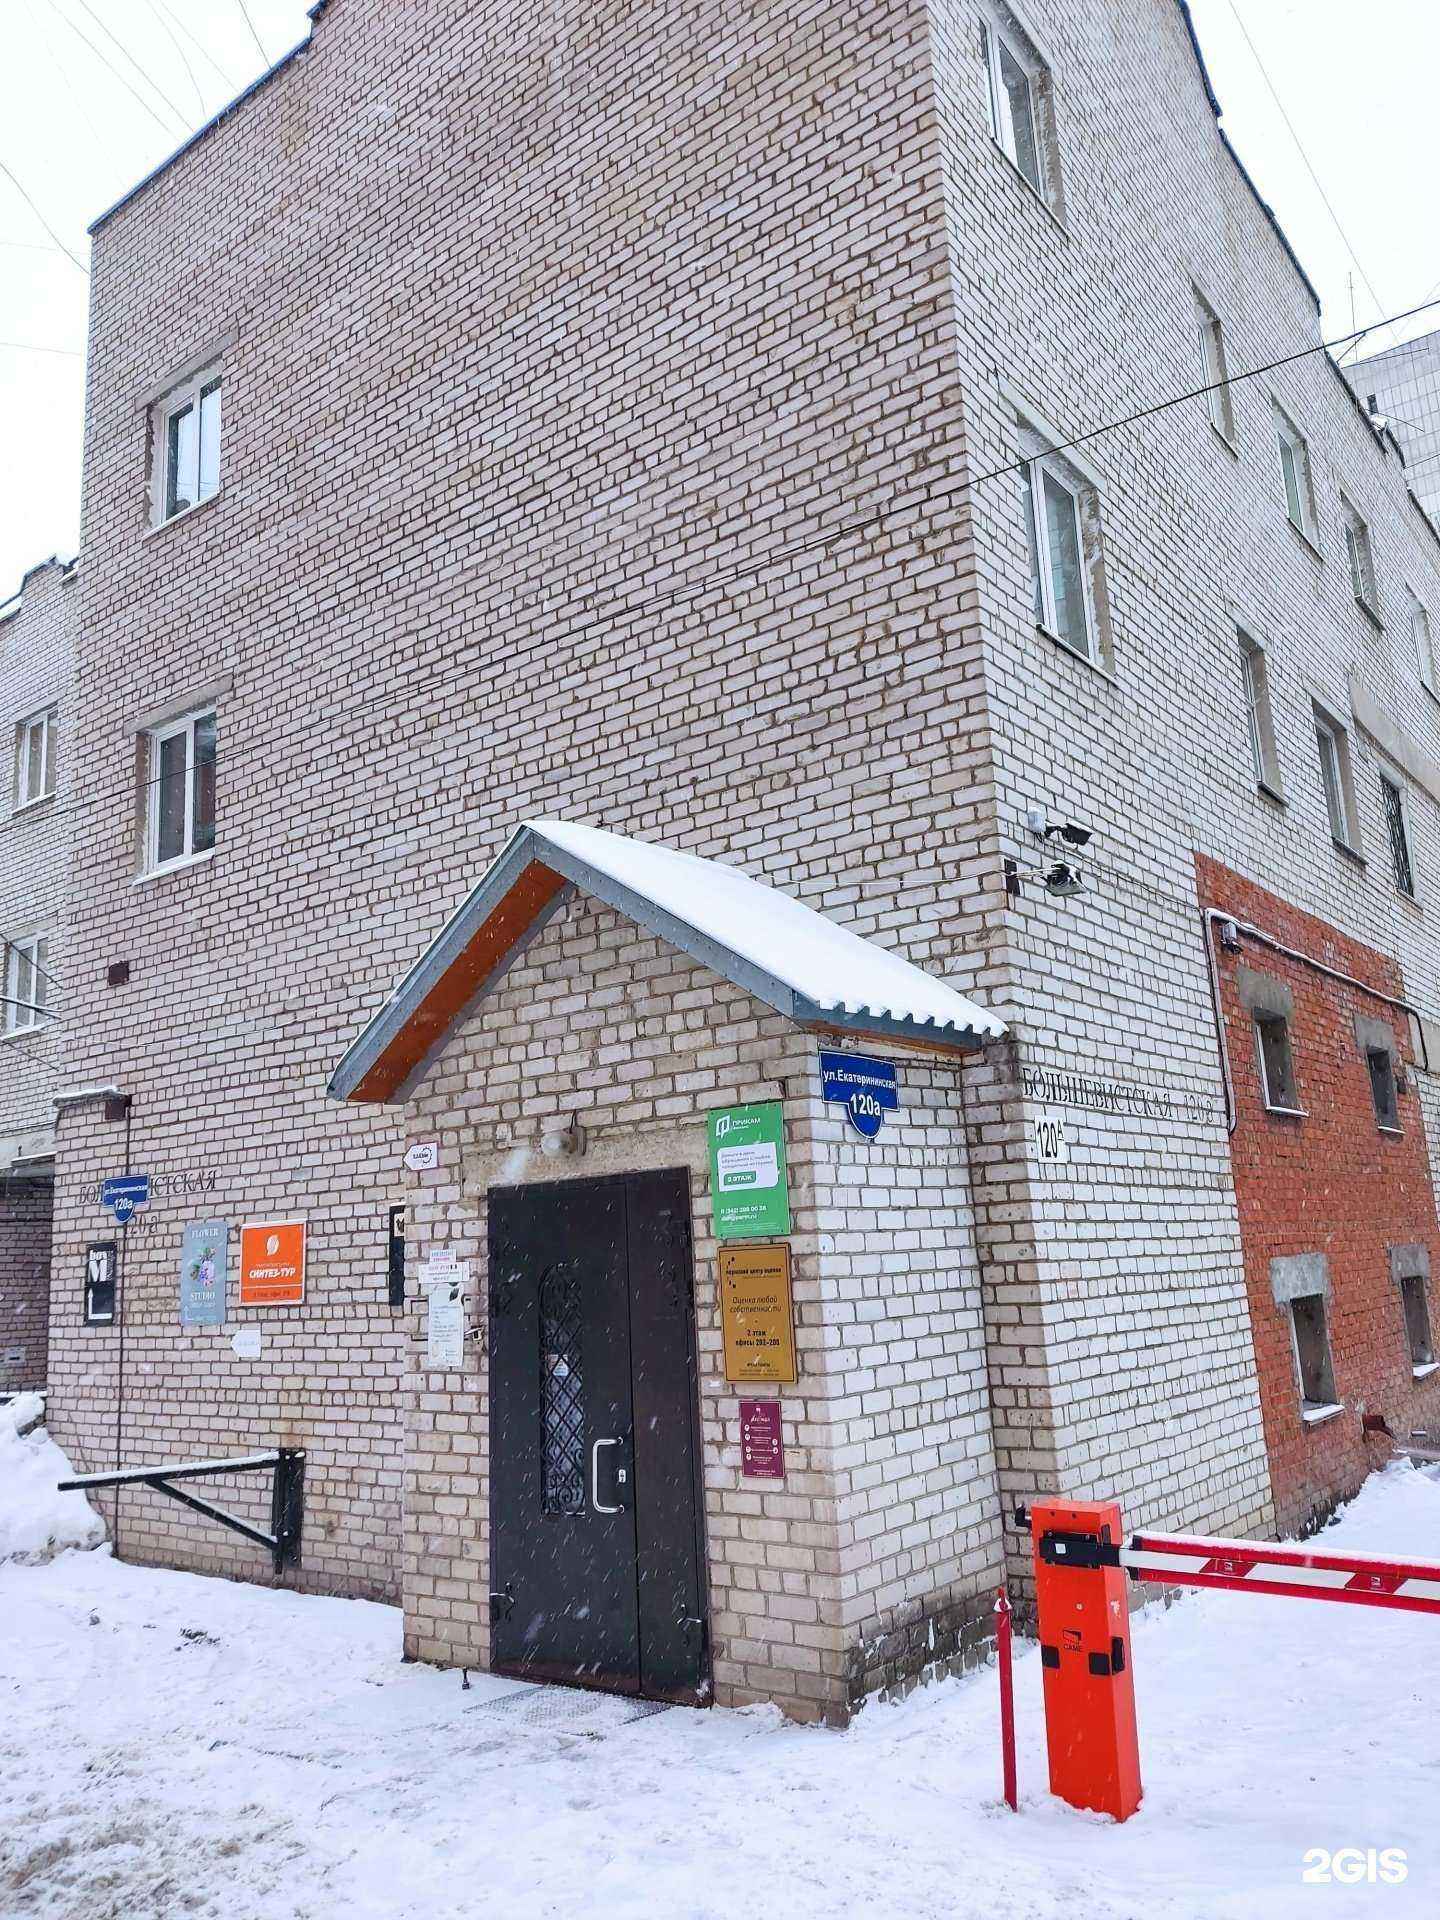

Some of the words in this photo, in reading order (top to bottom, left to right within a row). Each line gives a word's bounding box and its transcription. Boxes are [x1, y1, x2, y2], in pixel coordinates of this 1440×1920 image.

[823, 1069, 896, 1089] ул.Екатерининская
[1022, 1066, 1173, 1118] БОЛЬШЕВИСТСКАЯ
[850, 1093, 880, 1116] 120а
[114, 1197, 133, 1210] 120а
[191, 1228, 219, 1239] FLOWER
[191, 1291, 216, 1301] STUDIO
[732, 1296, 755, 1305] Оценка
[756, 1295, 777, 1304] любой
[729, 1304, 781, 1313] собственности
